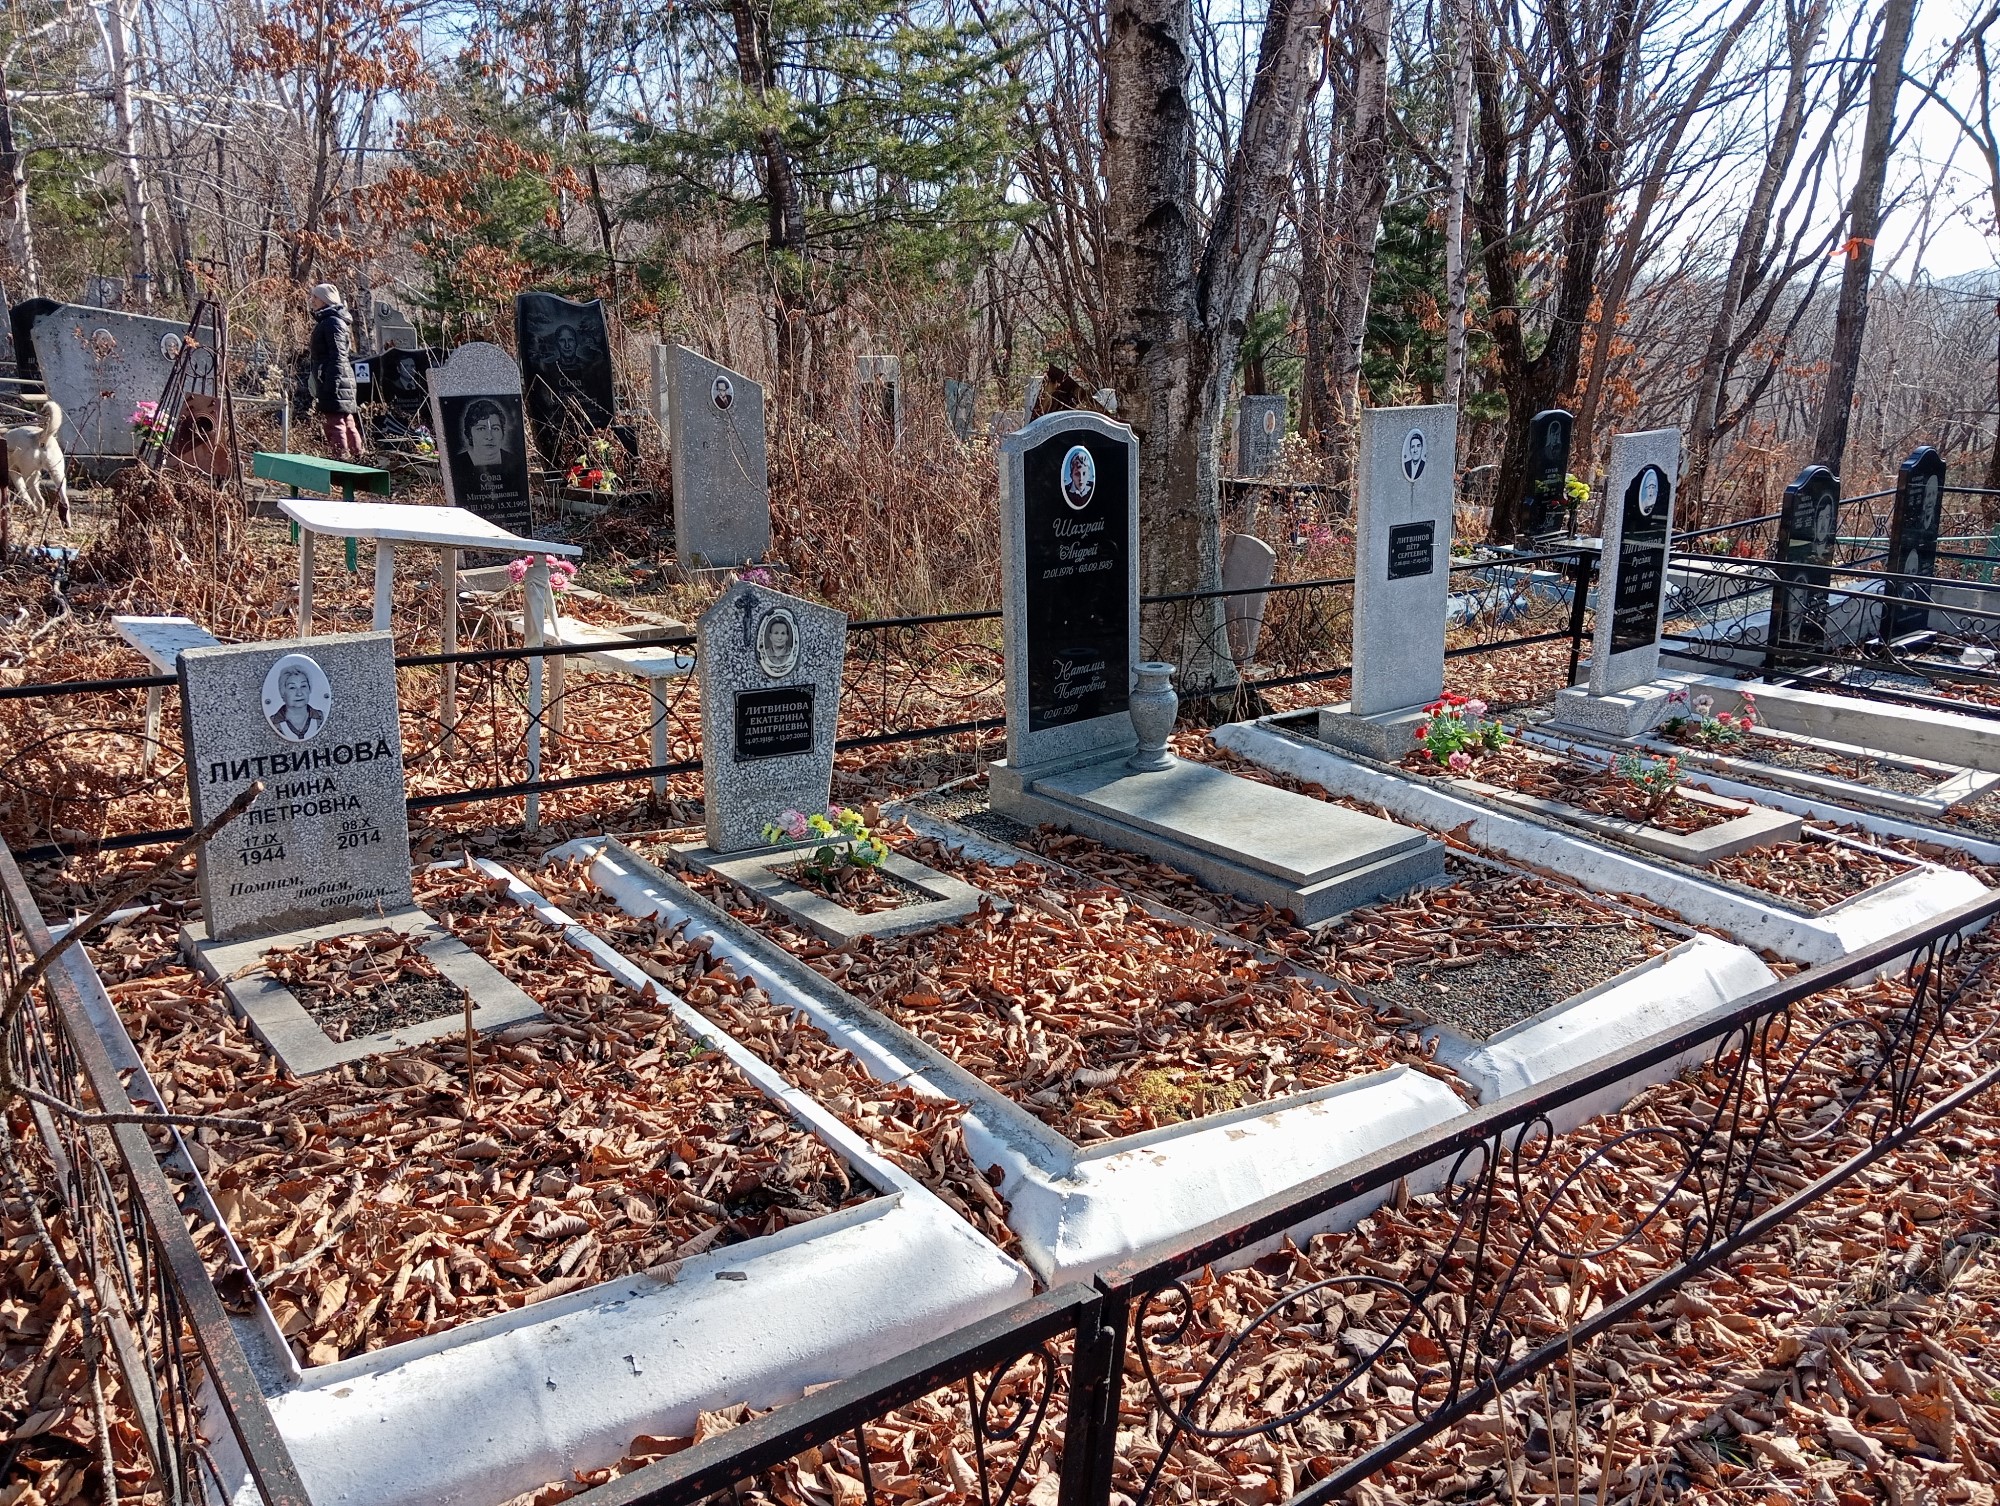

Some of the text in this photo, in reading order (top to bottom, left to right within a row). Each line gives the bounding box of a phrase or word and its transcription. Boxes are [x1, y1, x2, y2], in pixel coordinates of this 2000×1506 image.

[480, 473, 502, 482] Сова
[1052, 517, 1105, 539] Шахрай
[1397, 534, 1430, 544] ЛИТВИНОВ
[1060, 541, 1099, 563] Андрей
[1052, 659, 1106, 680] Наталия
[1053, 675, 1107, 699] Петровна
[745, 702, 809, 716] ЛИТВИНОВА
[745, 722, 809, 736] ДМИТРИЕВНА
[750, 713, 805, 726] ЕКАТЕРИНА
[210, 740, 393, 784] ЛИТВИНОВА
[276, 778, 337, 799] НИНА
[249, 795, 361, 825] ПЕТРОВНА
[342, 818, 372, 831] 08.X
[243, 833, 279, 847] 17.IX
[337, 830, 381, 850] 2014
[239, 846, 286, 866] 1944
[229, 876, 304, 897] Помним,
[294, 879, 353, 899] любим,
[321, 886, 398, 908] скорбим...
